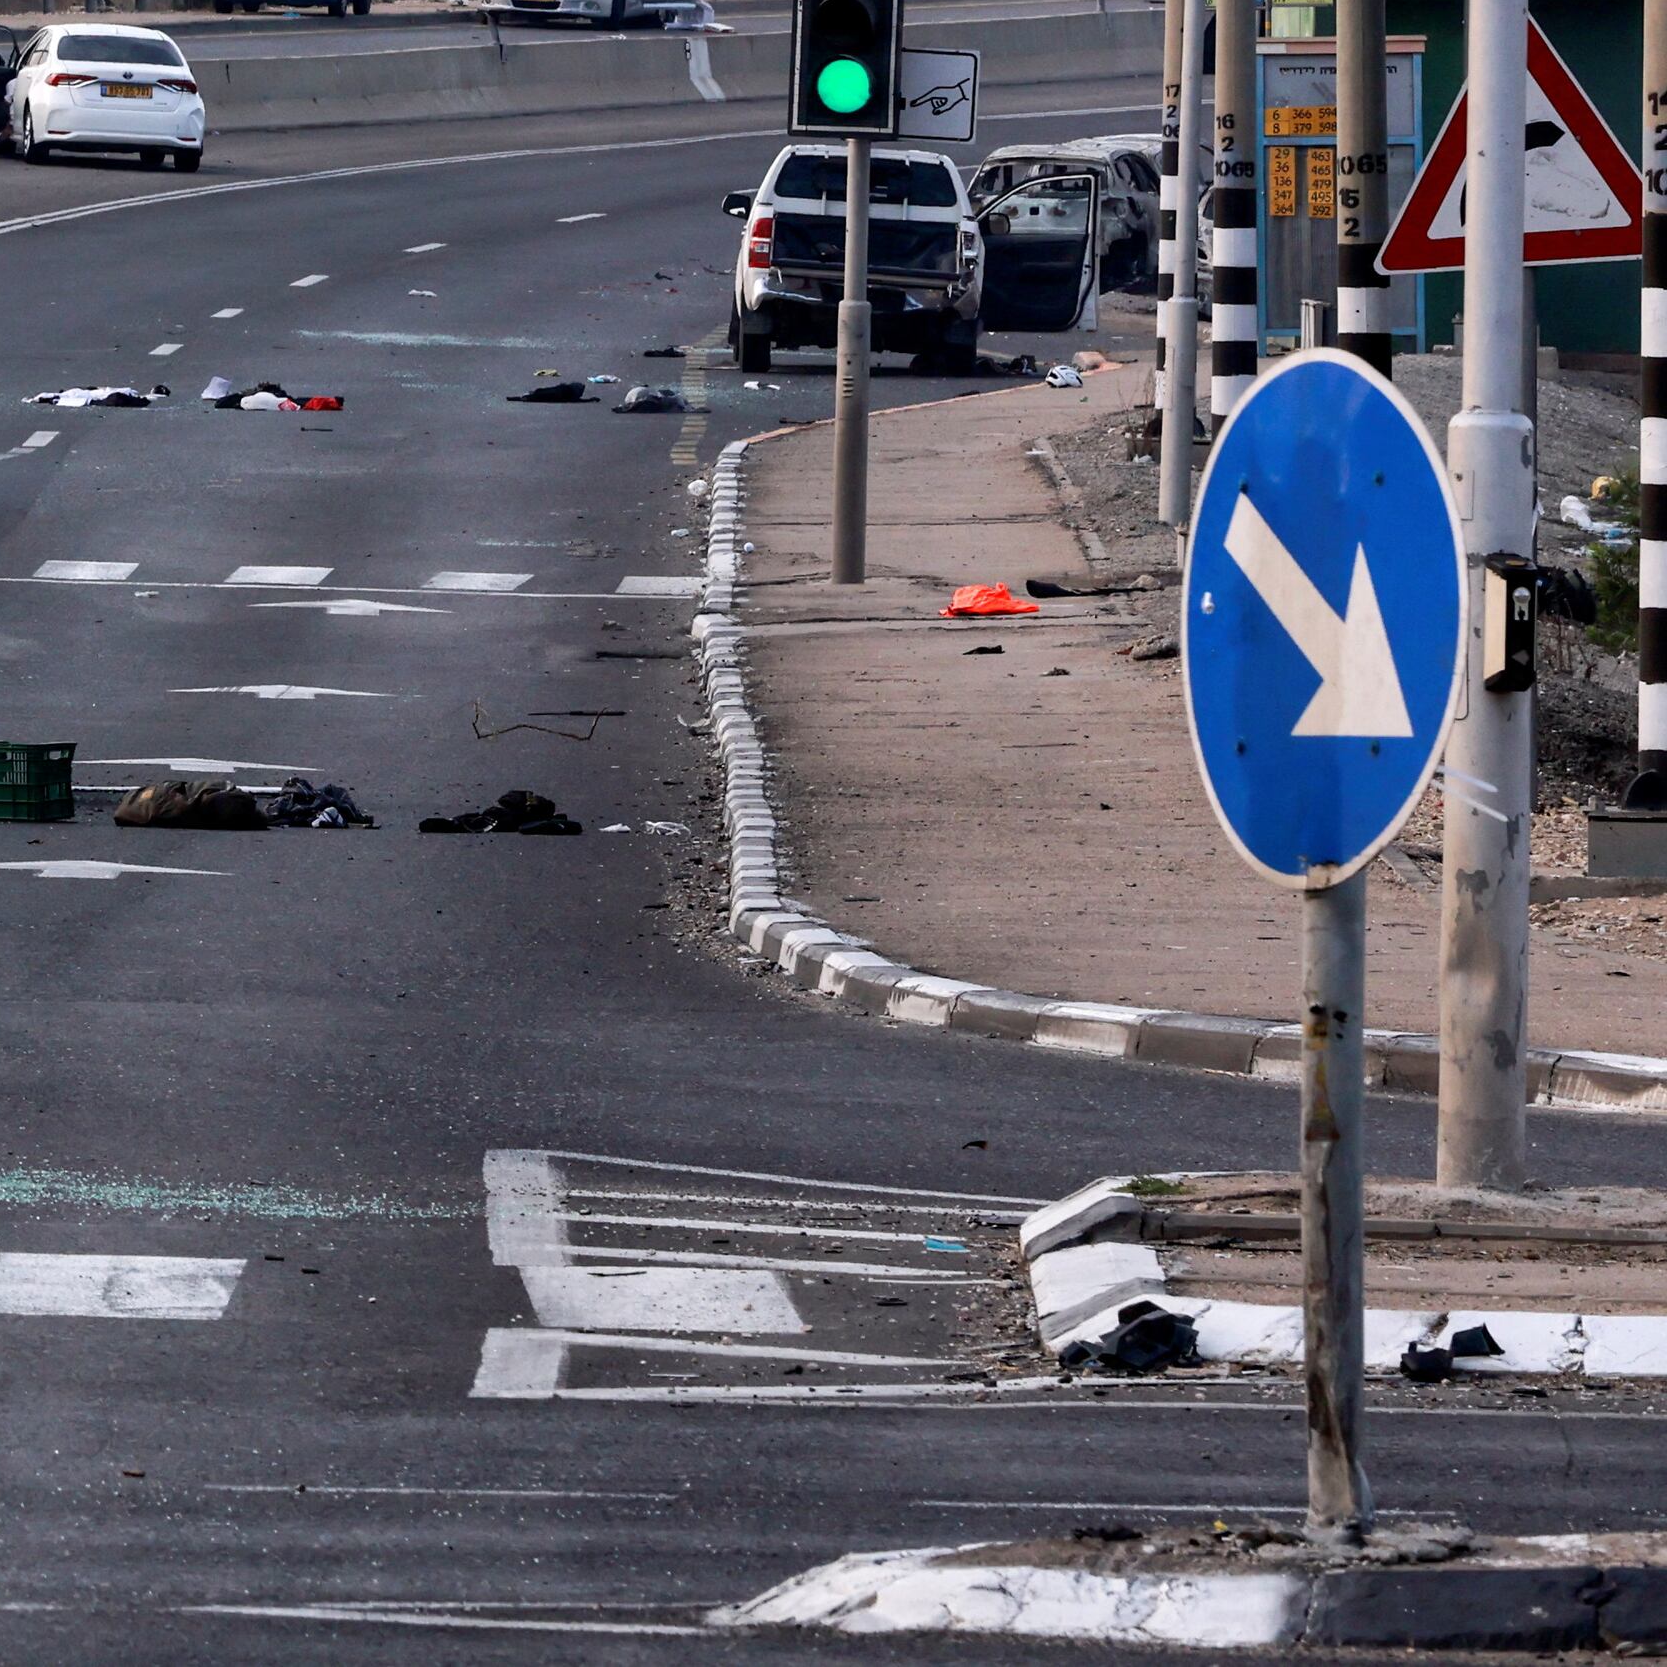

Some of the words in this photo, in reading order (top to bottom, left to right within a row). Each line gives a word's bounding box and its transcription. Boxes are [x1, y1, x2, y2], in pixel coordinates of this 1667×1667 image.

[1165, 84, 1180, 97] 17
[1167, 105, 1177, 118] 2
[1272, 110, 1280, 120] 6
[1292, 109, 1312, 119] 366
[1216, 114, 1234, 129] 16
[1272, 123, 1280, 133] 8
[1293, 123, 1312, 133] 379
[1318, 122, 1337, 132] 598
[1222, 137, 1234, 152] 2
[1275, 149, 1290, 159] 29
[1311, 151, 1331, 162] 463
[1275, 162, 1289, 172] 36
[1311, 165, 1331, 175] 465
[1274, 176, 1292, 186] 136
[1312, 179, 1332, 189] 479
[1274, 190, 1292, 200] 347
[1311, 192, 1331, 203] 495
[1275, 205, 1293, 214] 364
[1312, 206, 1331, 216] 592
[1344, 218, 1360, 237] 2
